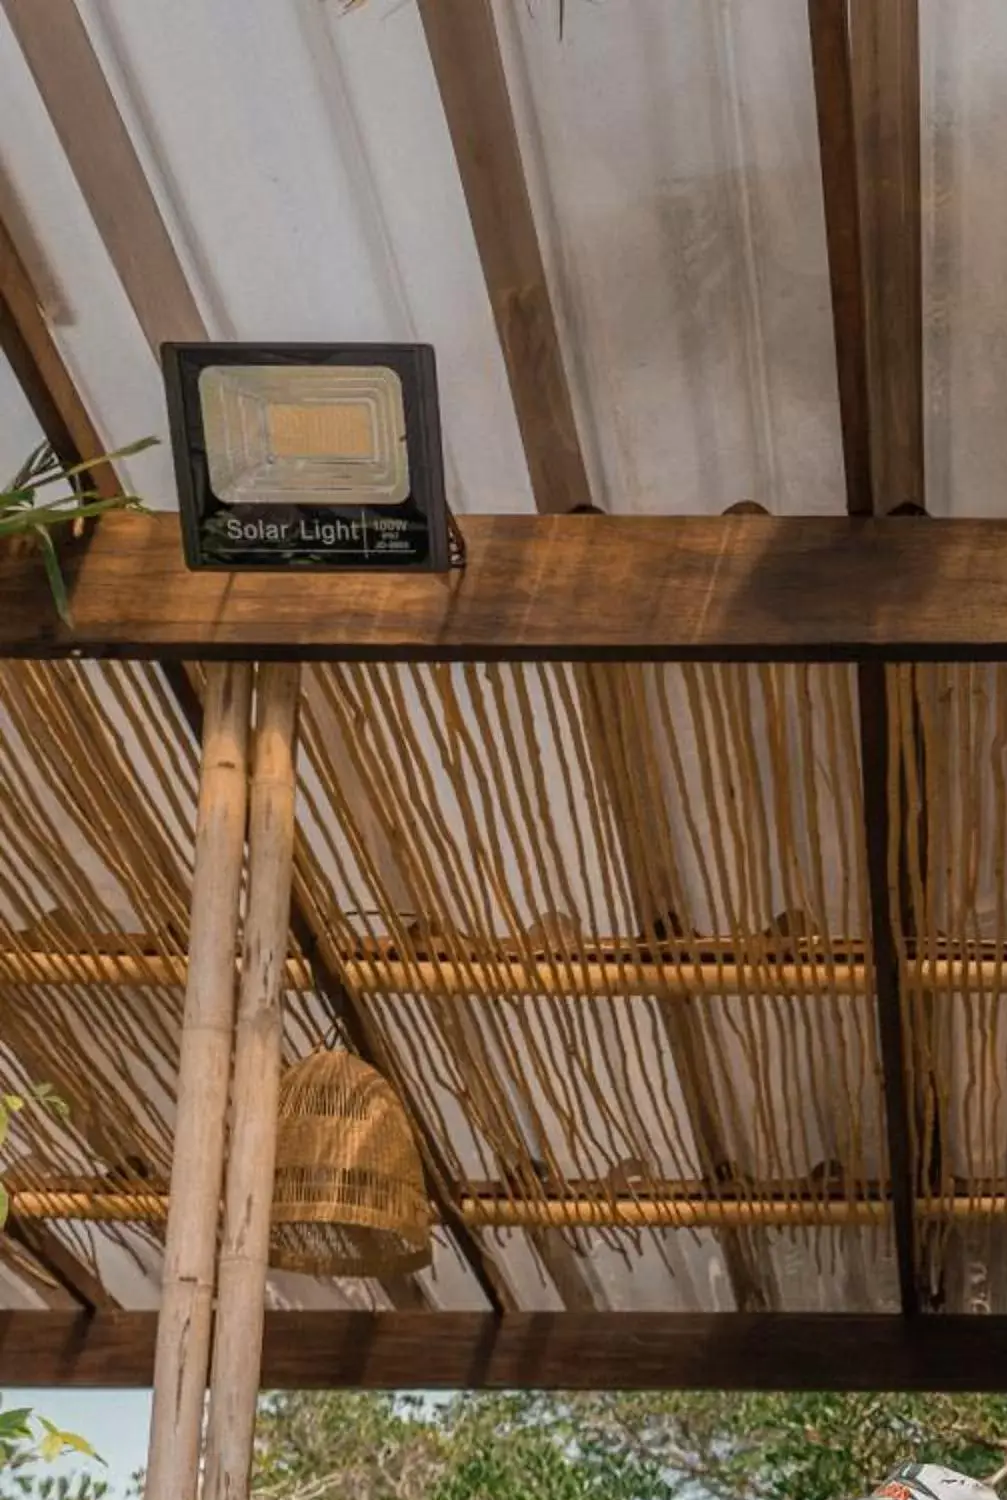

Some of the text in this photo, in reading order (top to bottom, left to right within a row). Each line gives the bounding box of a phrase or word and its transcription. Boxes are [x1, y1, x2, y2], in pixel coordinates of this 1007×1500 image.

[227, 518, 360, 545] Solar Light
[373, 519, 408, 531] 100W
